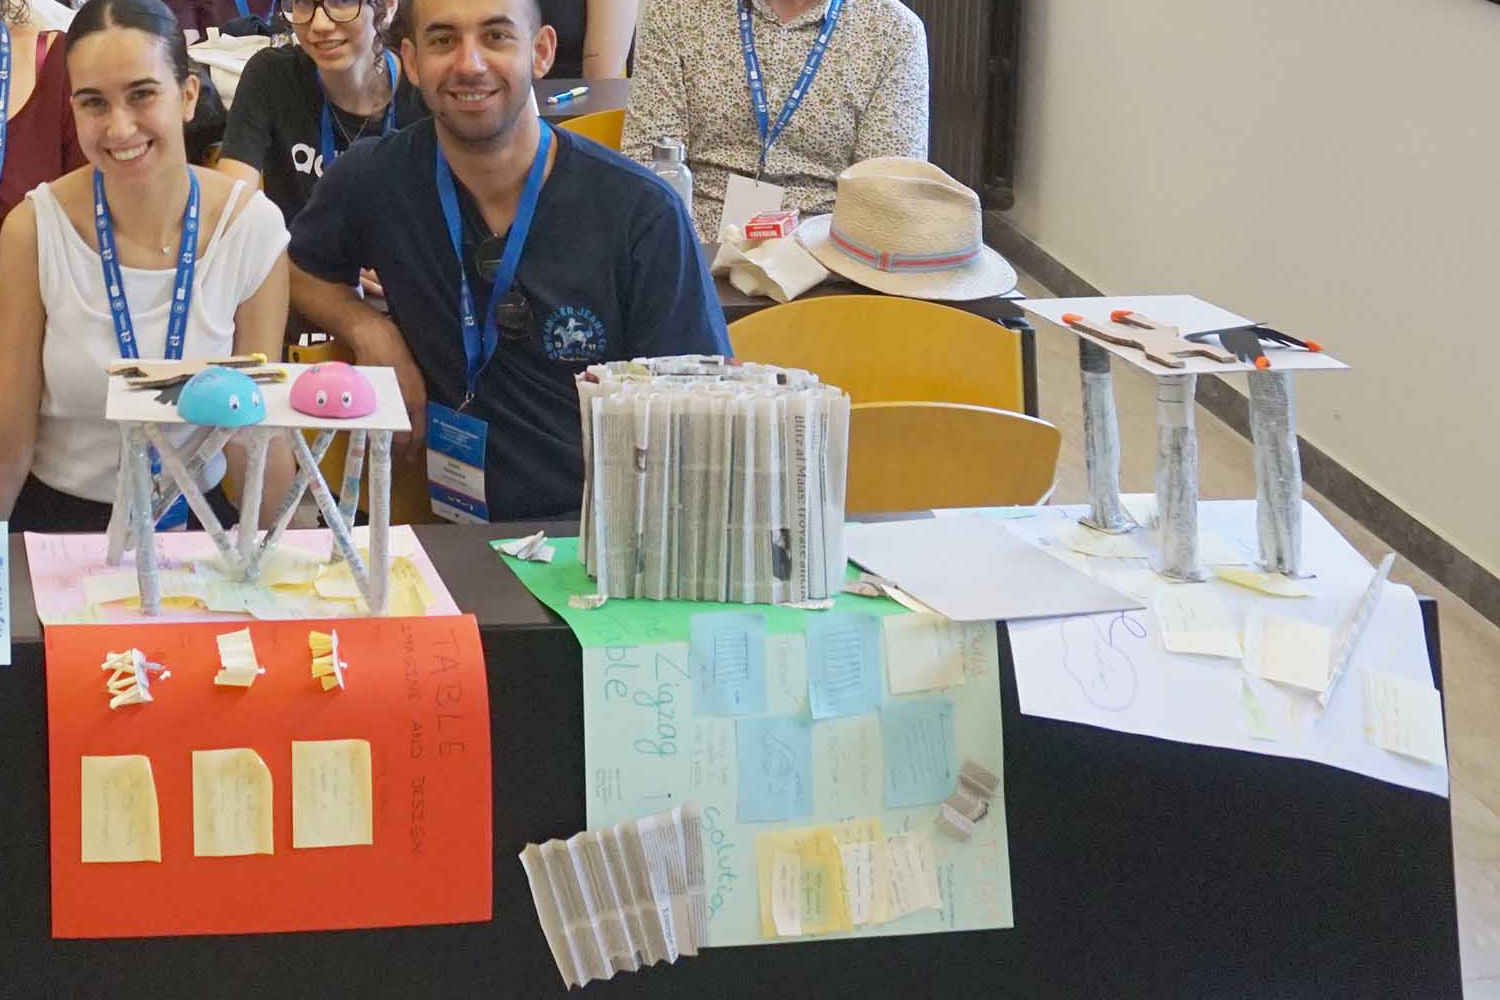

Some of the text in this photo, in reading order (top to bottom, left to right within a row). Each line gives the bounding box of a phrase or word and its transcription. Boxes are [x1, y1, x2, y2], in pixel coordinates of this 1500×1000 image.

[795, 416, 806, 443] Blitz
[399, 622, 425, 854] IMAGINE AND DESIGN
[431, 627, 468, 757] TABLE
[633, 650, 691, 757] Zigzag
